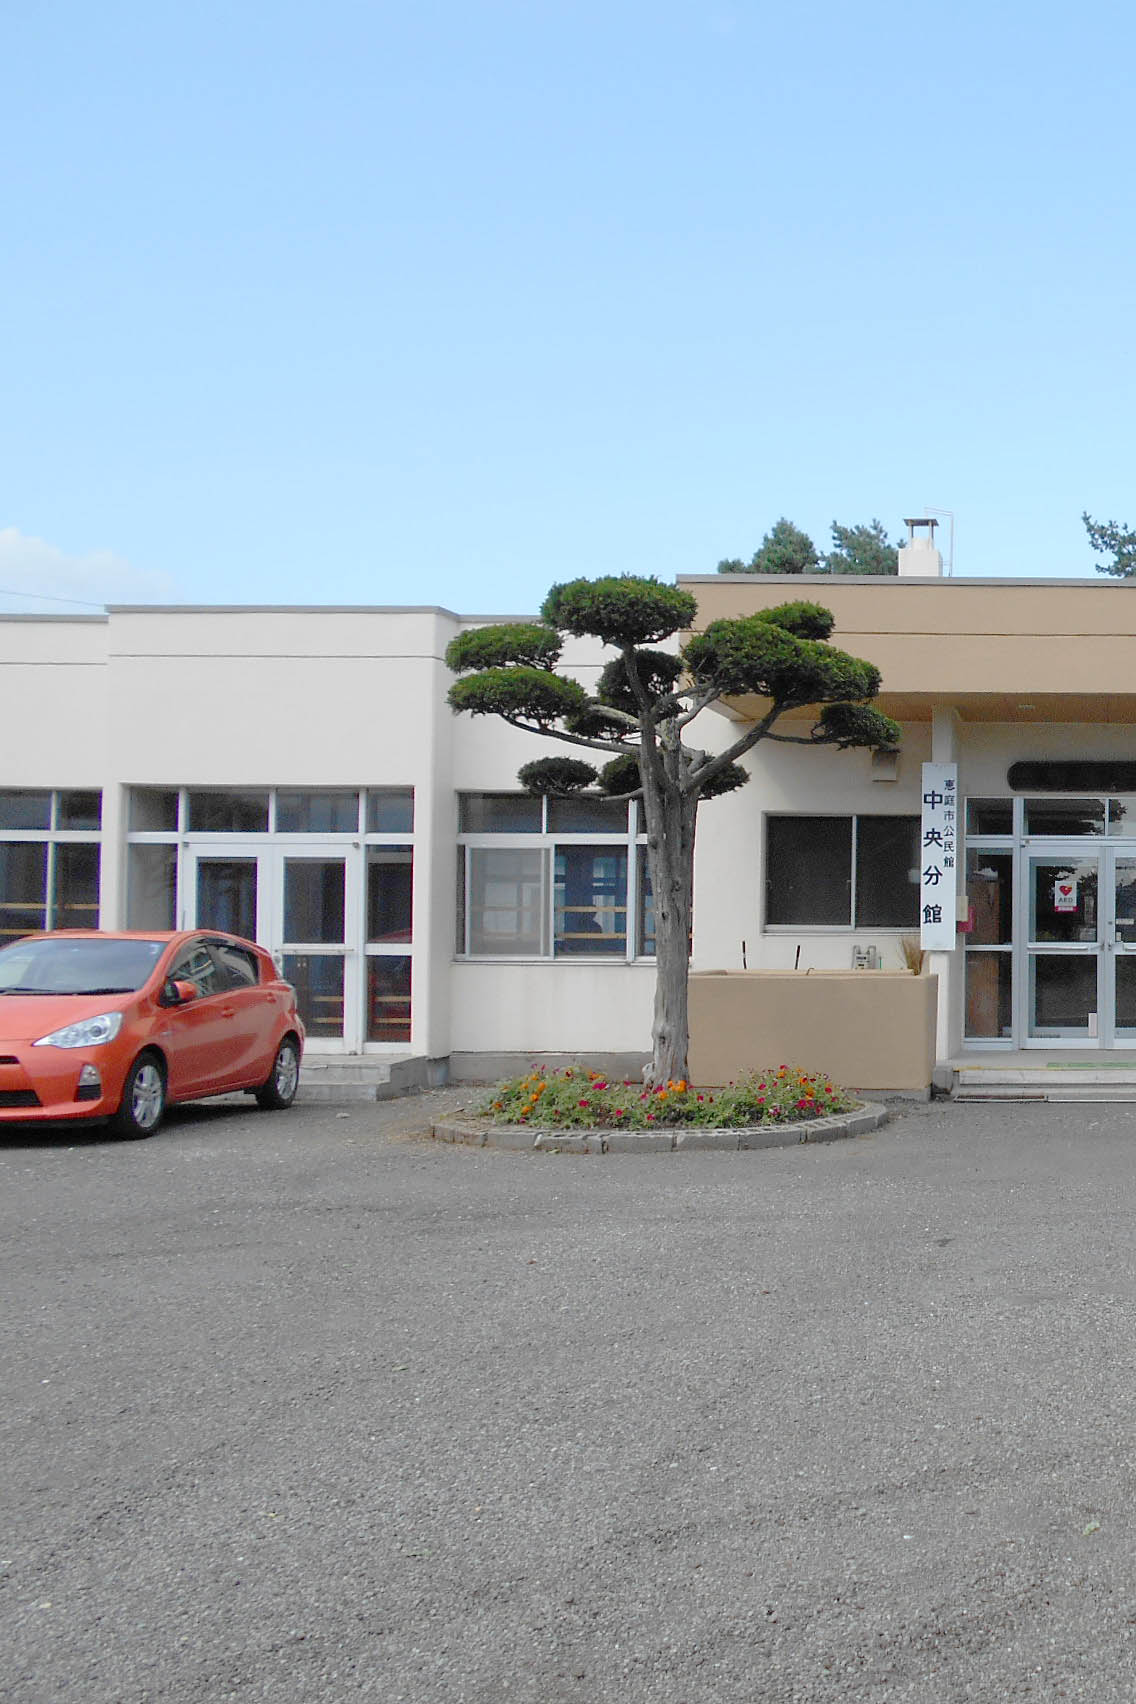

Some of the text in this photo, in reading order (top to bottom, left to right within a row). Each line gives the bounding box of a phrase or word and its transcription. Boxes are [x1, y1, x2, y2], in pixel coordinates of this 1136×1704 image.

[923, 790, 943, 924] 中央分館
[944, 780, 955, 868] 恵庭市公民館
